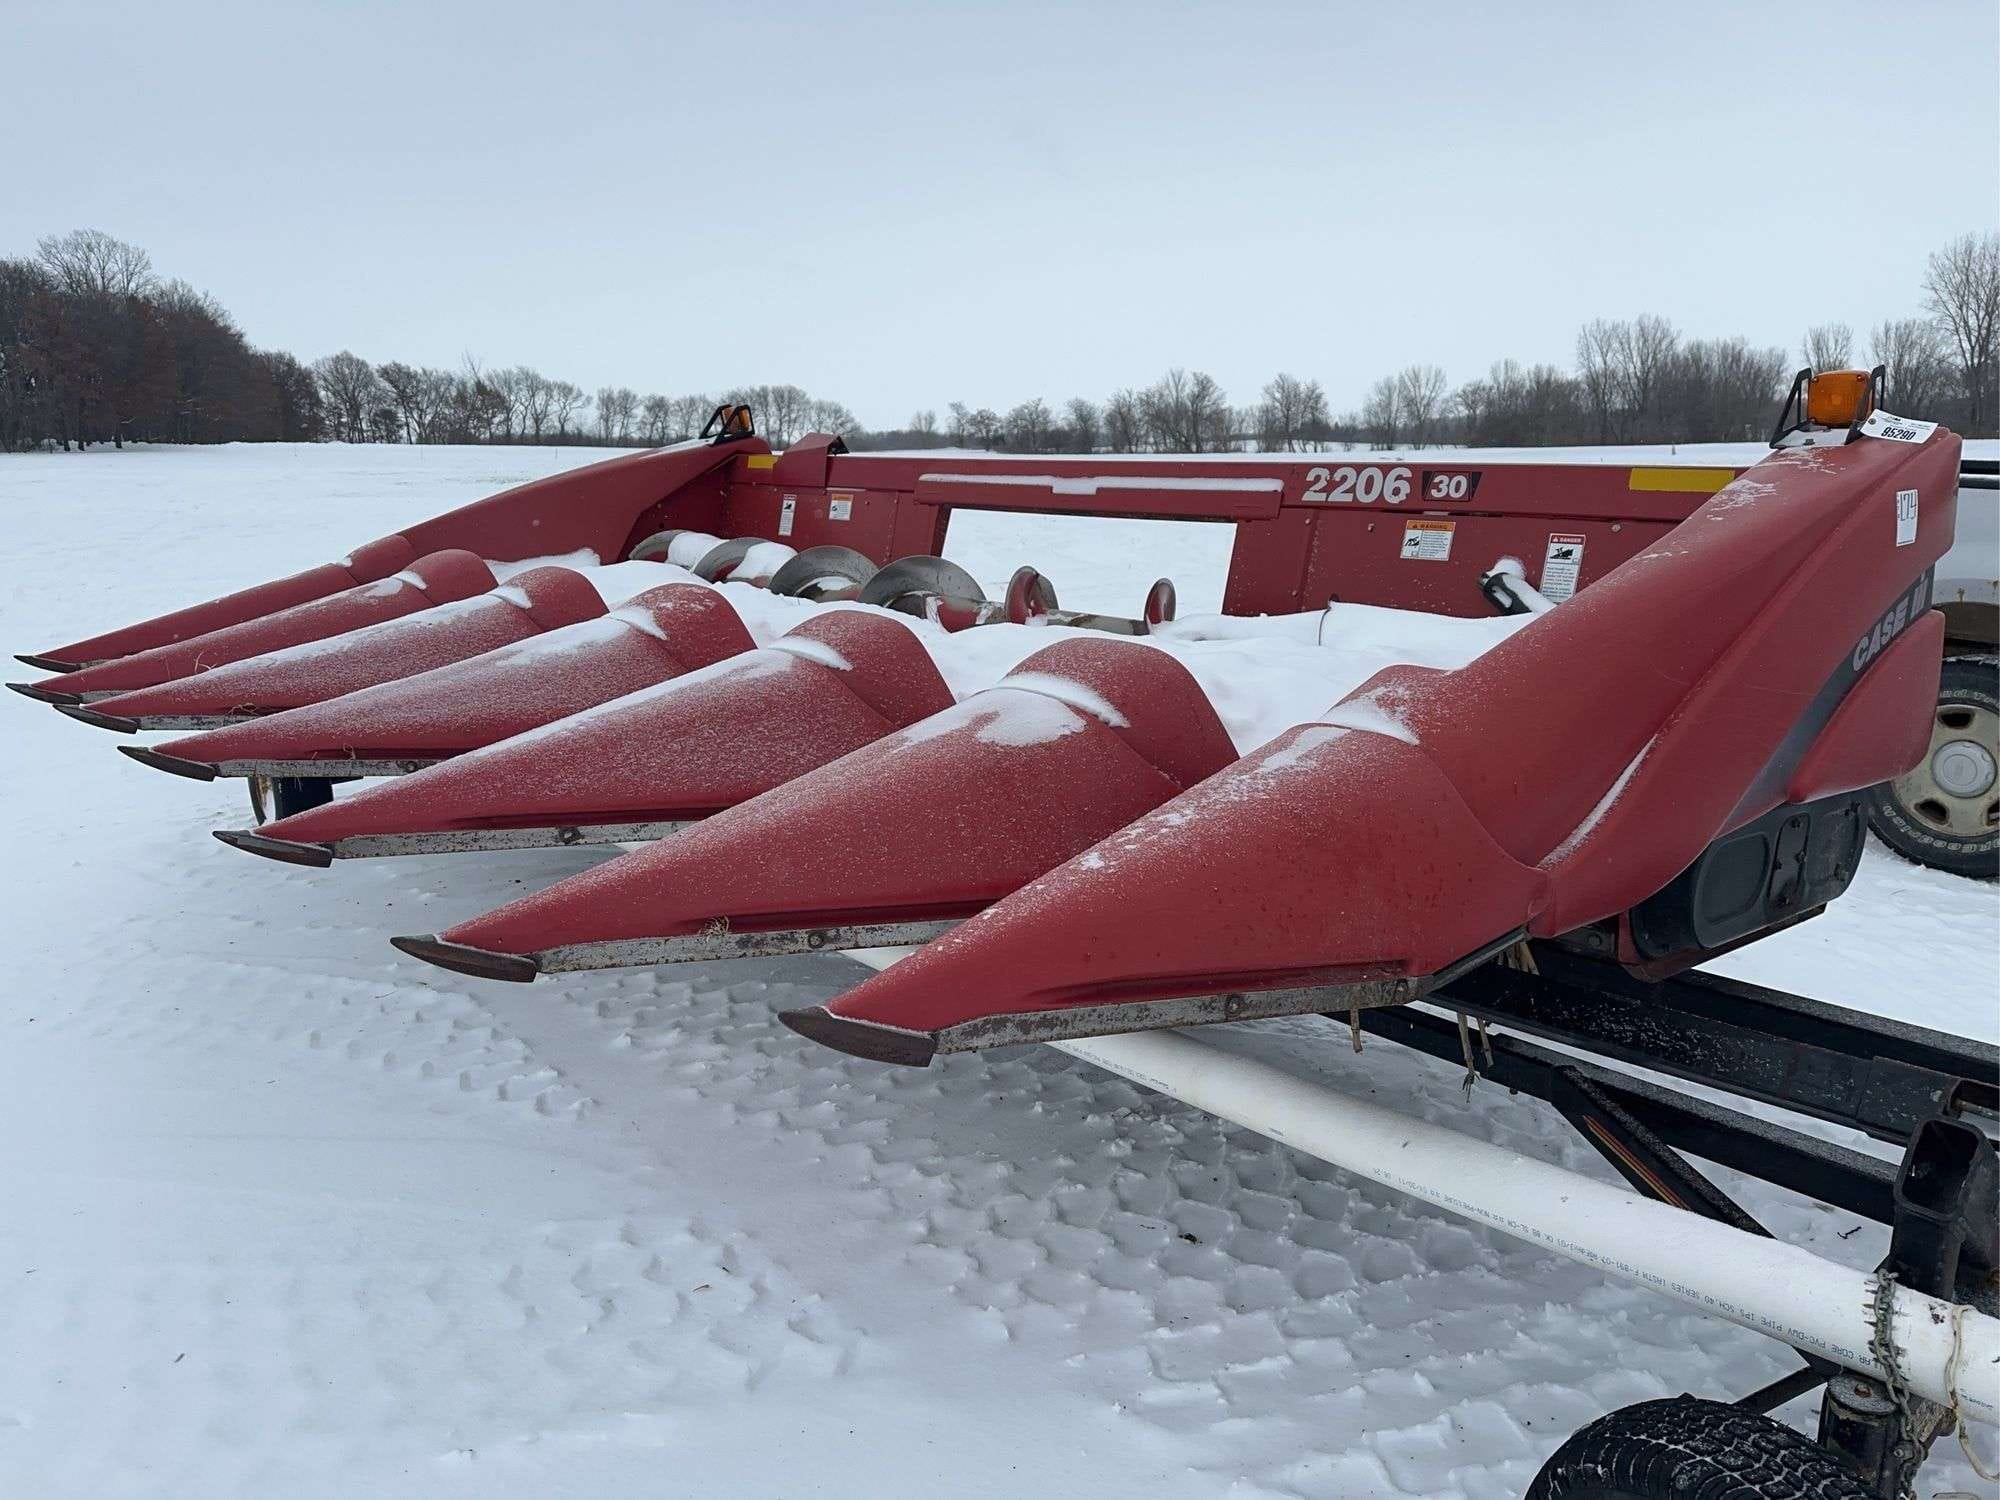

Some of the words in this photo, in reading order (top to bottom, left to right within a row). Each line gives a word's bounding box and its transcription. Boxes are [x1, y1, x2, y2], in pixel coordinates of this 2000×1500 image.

[1881, 427, 1917, 441] 95290
[1301, 466, 1412, 504] 2206
[1430, 475, 1468, 499] 30
[1853, 596, 1910, 672] CASE
[1760, 1317, 1783, 1332] PIPE
[1831, 1344, 1854, 1360] CORE
